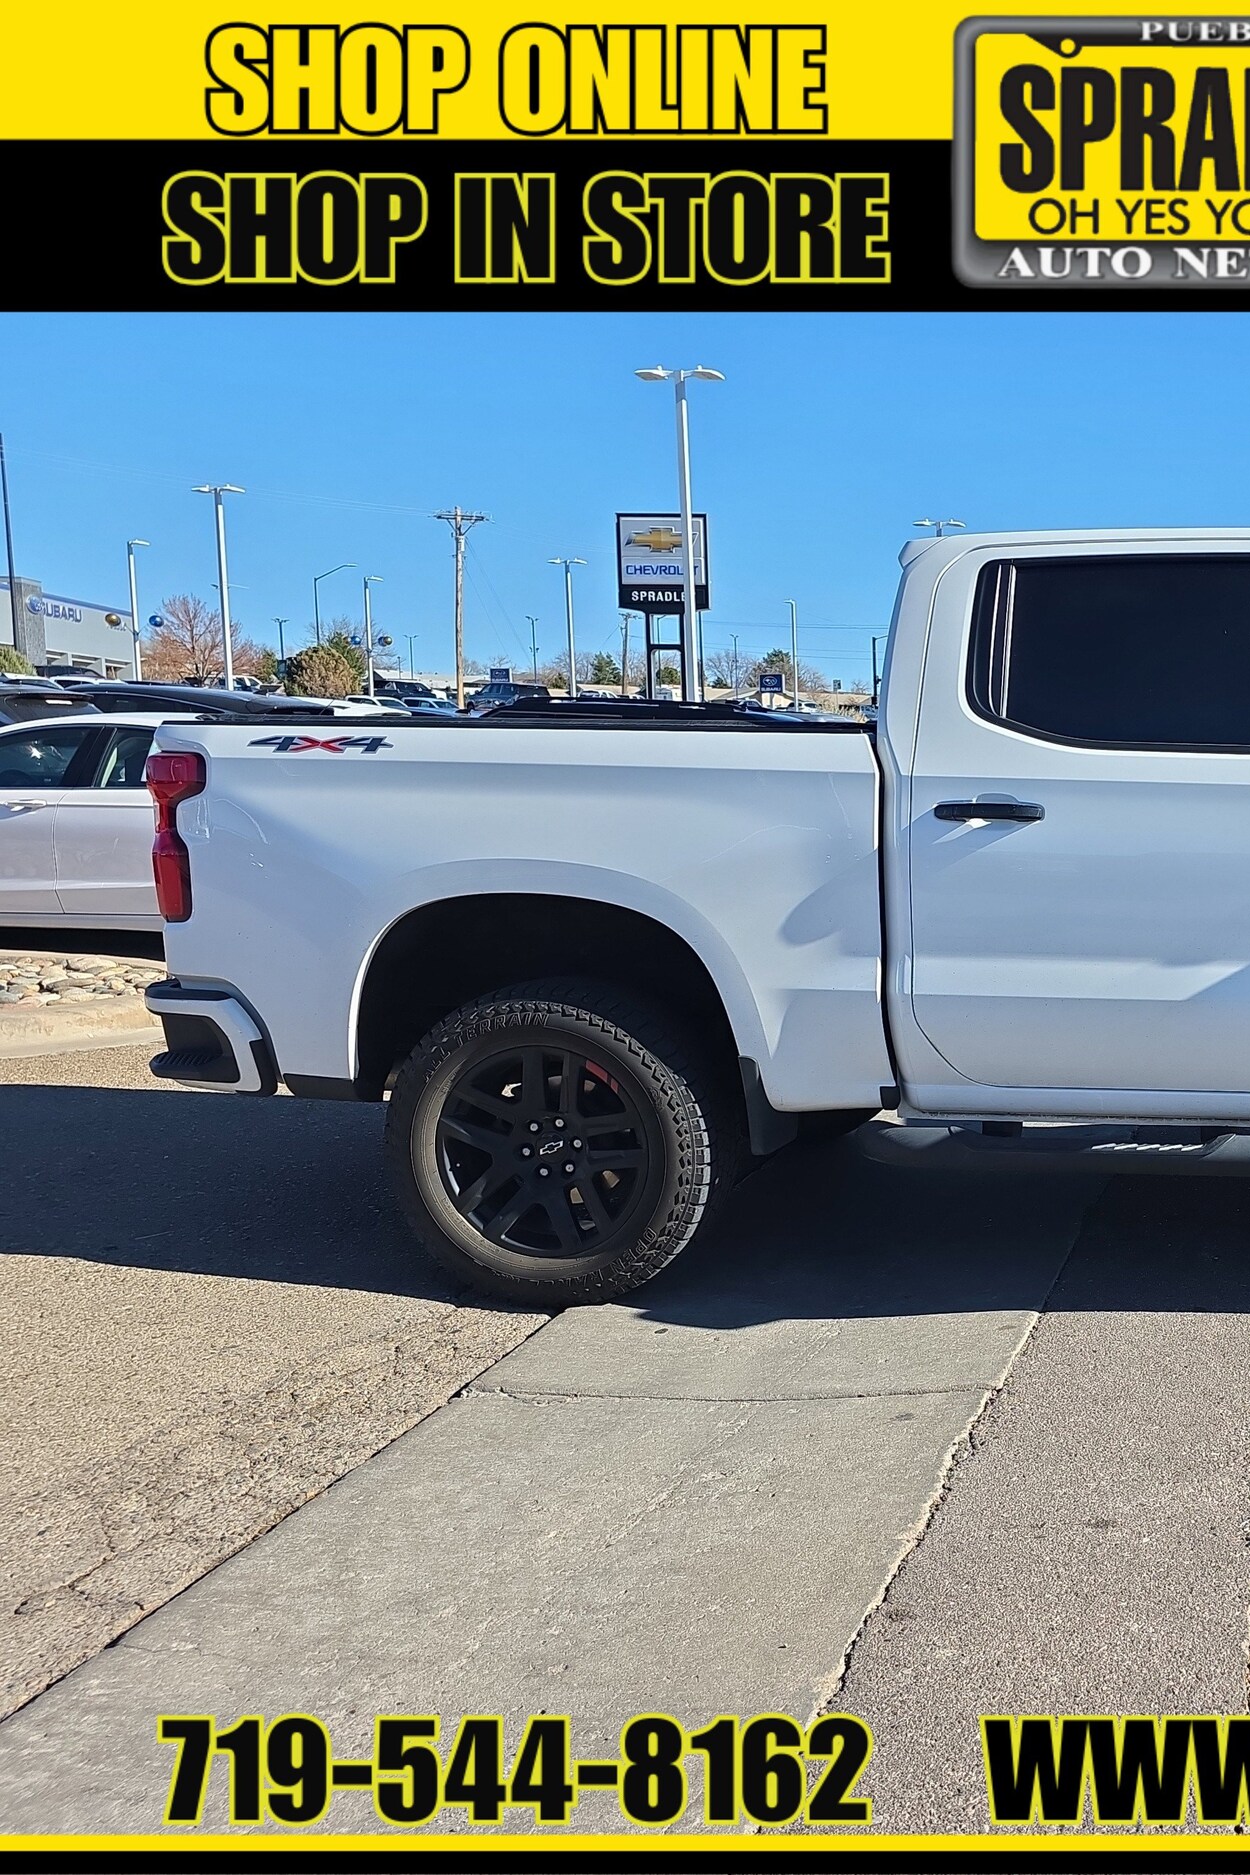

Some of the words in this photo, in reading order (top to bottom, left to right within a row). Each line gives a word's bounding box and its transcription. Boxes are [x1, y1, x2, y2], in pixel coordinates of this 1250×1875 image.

[625, 565, 698, 575] CHEVROLT
[631, 591, 695, 601] SPRADLE
[40, 601, 82, 623] SUBARU
[453, 1011, 550, 1047] TERRAIN
